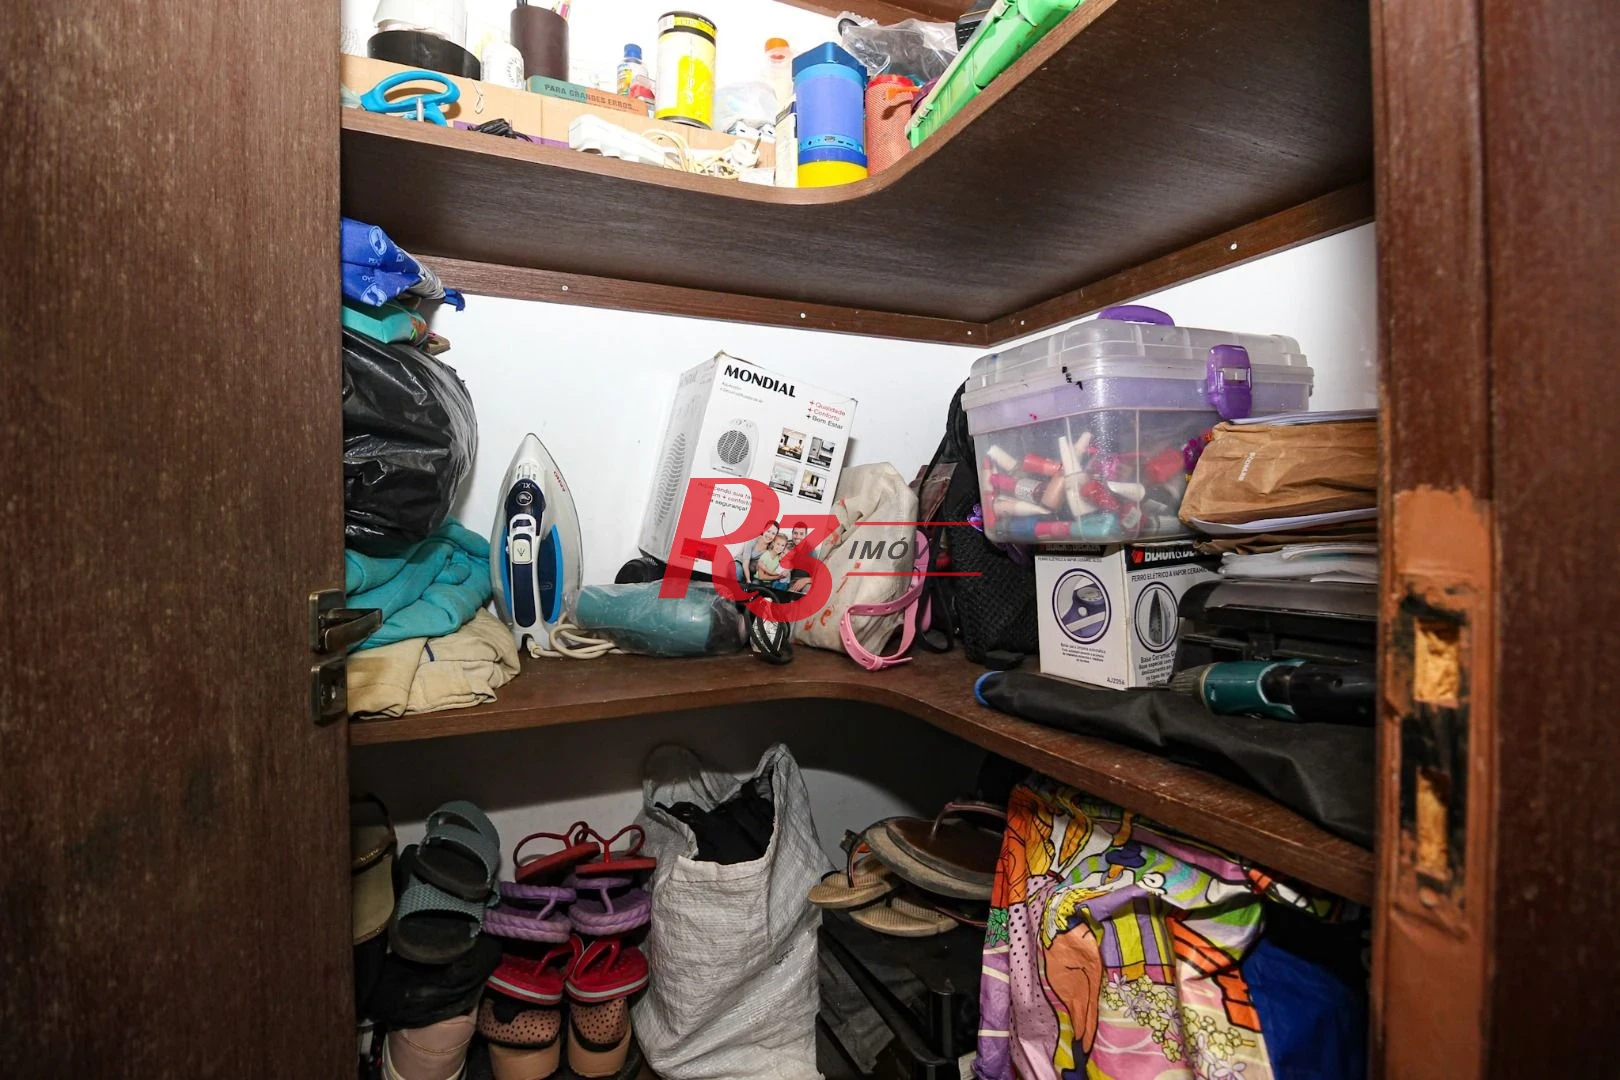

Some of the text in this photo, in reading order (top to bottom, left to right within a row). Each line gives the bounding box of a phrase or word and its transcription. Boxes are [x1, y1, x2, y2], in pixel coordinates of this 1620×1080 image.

[544, 83, 567, 95] PARA
[569, 88, 606, 104] GRANDES
[724, 364, 796, 398] MONDIAL
[813, 408, 840, 422] Conforto
[1131, 573, 1147, 582] FERRO
[1173, 568, 1187, 577] VAPOR
